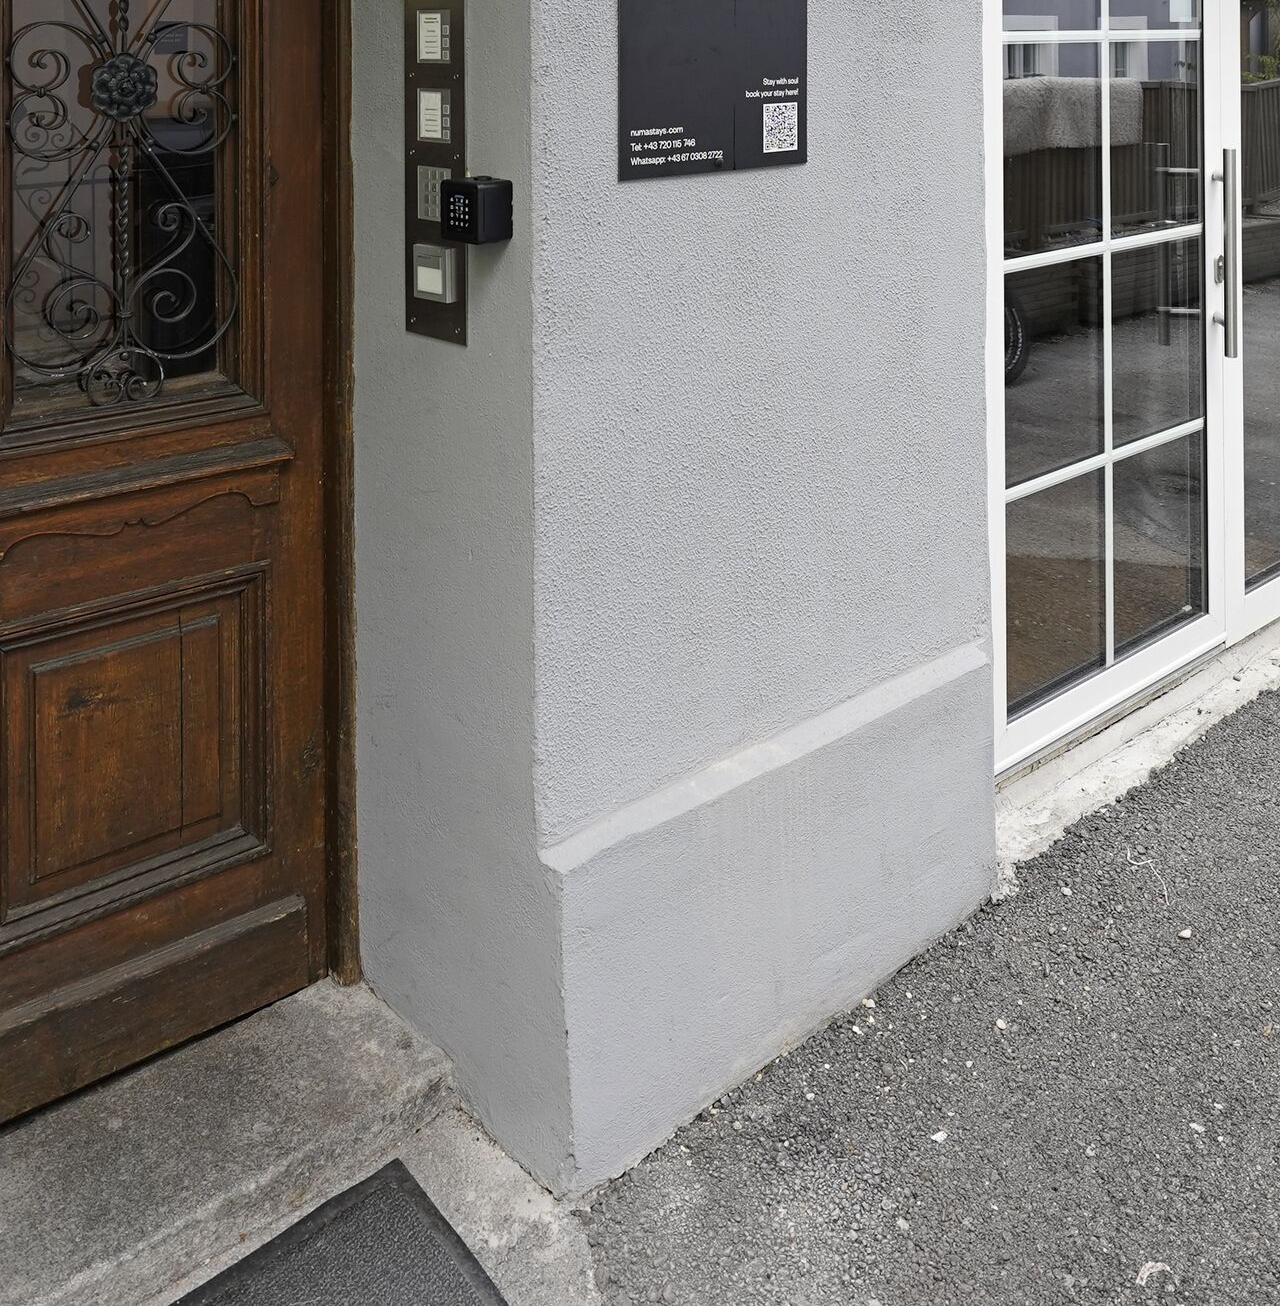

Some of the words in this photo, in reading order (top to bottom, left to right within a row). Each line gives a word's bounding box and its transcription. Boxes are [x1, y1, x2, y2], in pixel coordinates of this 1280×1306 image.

[762, 77, 776, 87] Stay
[776, 77, 788, 85] with
[788, 76, 799, 85] soul
[745, 89, 760, 98] book
[760, 90, 773, 99] your
[773, 89, 784, 98] stay
[630, 126, 684, 137] numastays.com
[643, 141, 658, 150] +43
[658, 140, 672, 149] 720
[672, 139, 682, 148] 115
[683, 138, 696, 147] 746
[630, 156, 666, 166] Whatsapp:
[667, 153, 680, 163] +43
[681, 152, 690, 161] 67
[690, 151, 708, 161] 0308
[708, 150, 723, 159] 2722
